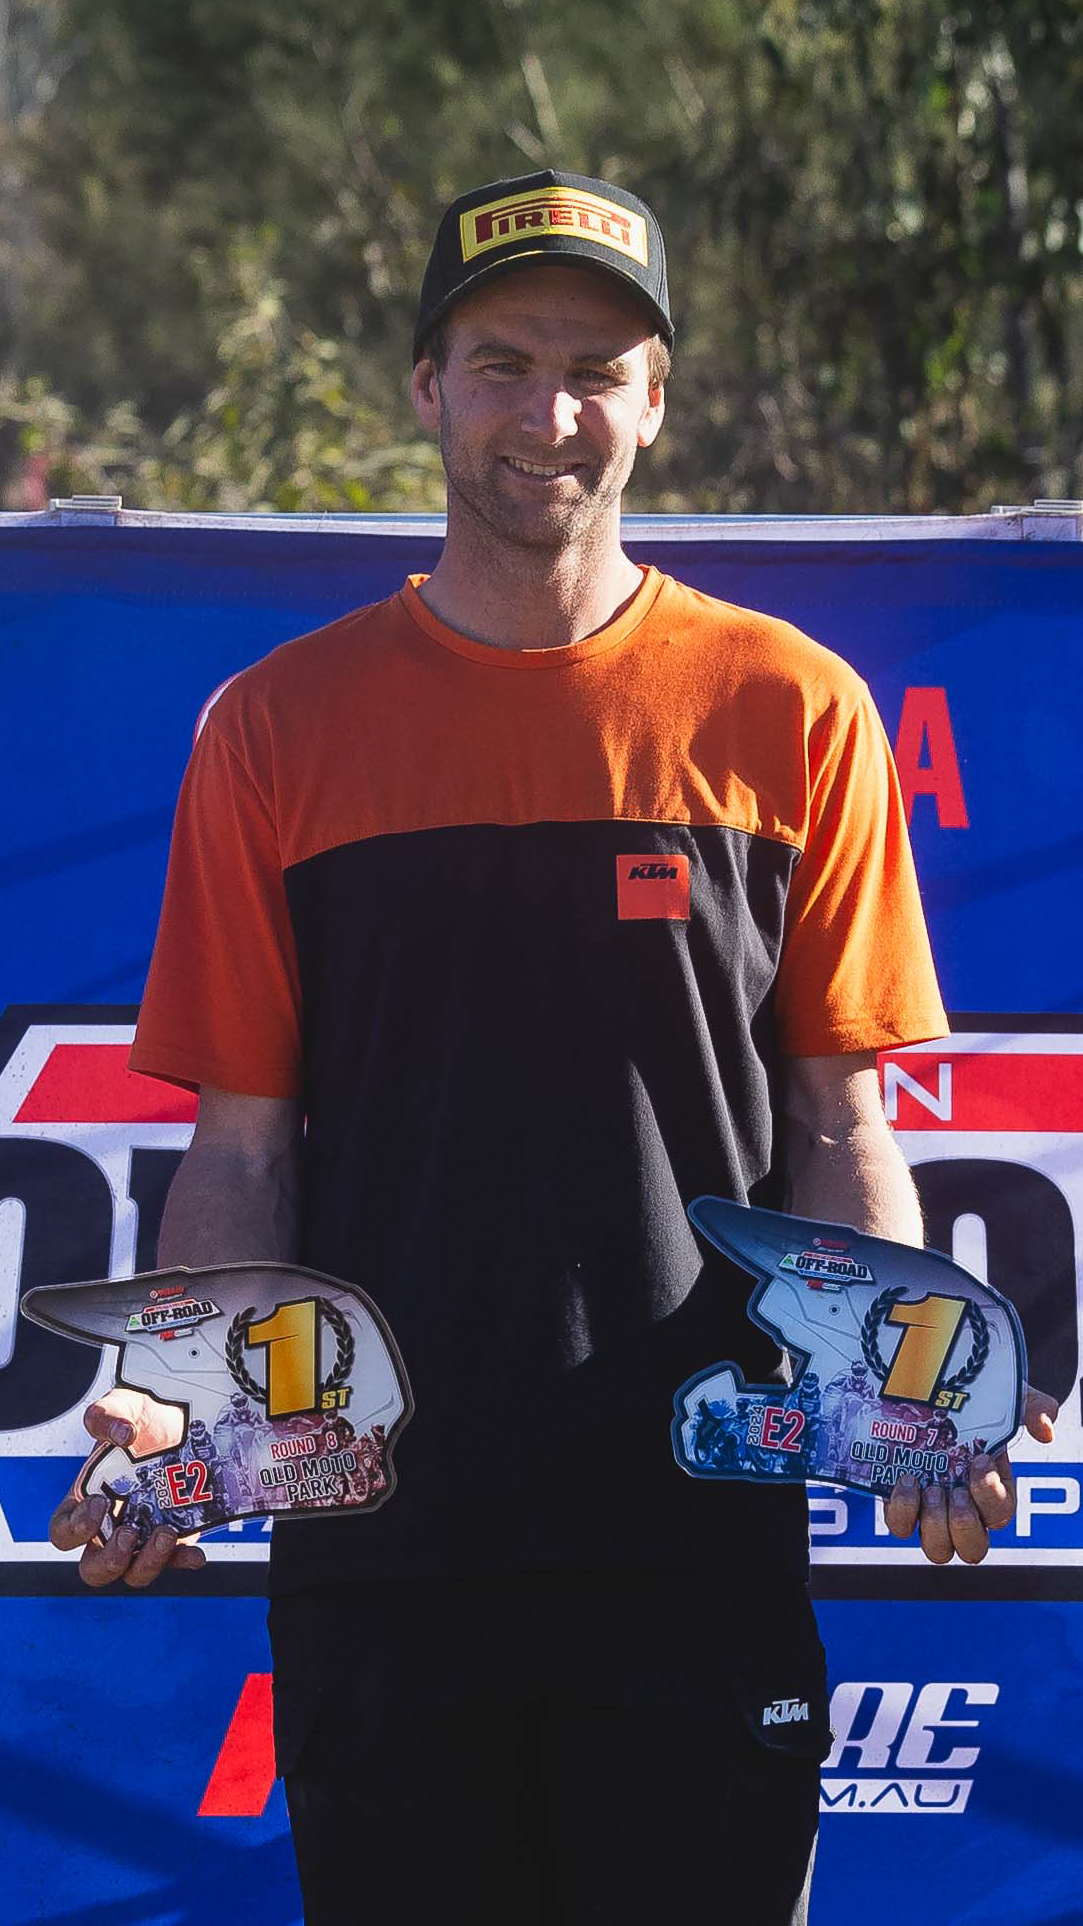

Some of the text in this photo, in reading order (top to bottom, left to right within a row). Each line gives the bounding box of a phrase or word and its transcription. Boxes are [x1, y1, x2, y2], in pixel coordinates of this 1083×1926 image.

[474, 197, 631, 246] PIRELLI
[628, 862, 678, 880] KTM
[795, 1255, 868, 1279] OFF-ROAD
[141, 1300, 213, 1326] OFF-ROAD
[747, 1405, 764, 1445] 2024
[761, 1406, 805, 1453] E2
[870, 1420, 938, 1447] ROUND 7
[270, 1432, 337, 1461] ROUND 8
[851, 1441, 949, 1474] QLD MOTO
[165, 1461, 213, 1507] E2
[259, 1452, 356, 1487] QLD MOTO
[154, 1468, 172, 1510] 2024
[287, 1475, 339, 1503] PARK
[762, 1699, 809, 1726] KTM
